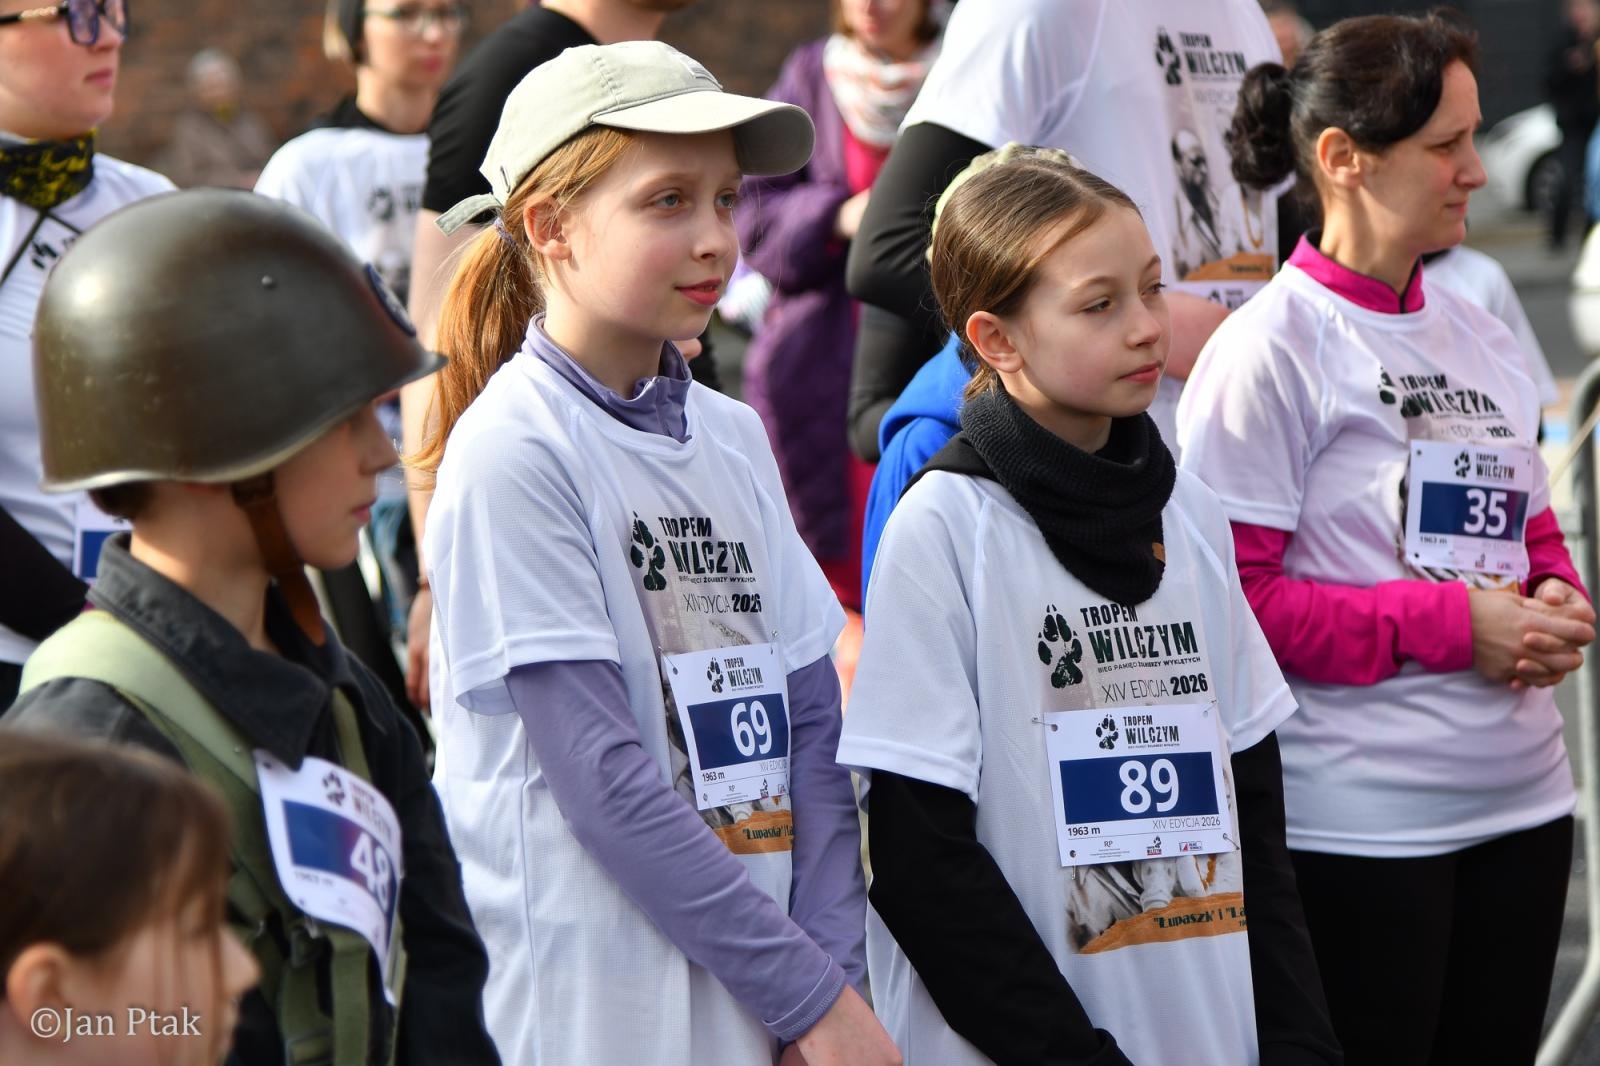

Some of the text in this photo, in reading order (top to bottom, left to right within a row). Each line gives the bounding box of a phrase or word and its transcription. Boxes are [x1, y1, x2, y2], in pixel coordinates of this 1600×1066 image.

[1475, 463, 1516, 480] WILCZYM
[1464, 488, 1508, 537] 35
[658, 517, 712, 538] TROPEM
[1080, 603, 1139, 628] TROPEM
[1087, 621, 1199, 664] WILCZYM
[724, 657, 745, 669] TROPEM
[727, 667, 763, 687] WILCZYM
[1101, 681, 1127, 703] XIV
[1170, 673, 1208, 696] 2026
[730, 700, 773, 757] 69
[1123, 715, 1153, 727] TROPEM
[1125, 725, 1180, 745] WILCZYM
[702, 771, 726, 782] 1963 m
[1119, 758, 1180, 814] 89
[1067, 827, 1101, 837] 1963 m
[1152, 816, 1221, 830] XIV EDYCJA 2026
